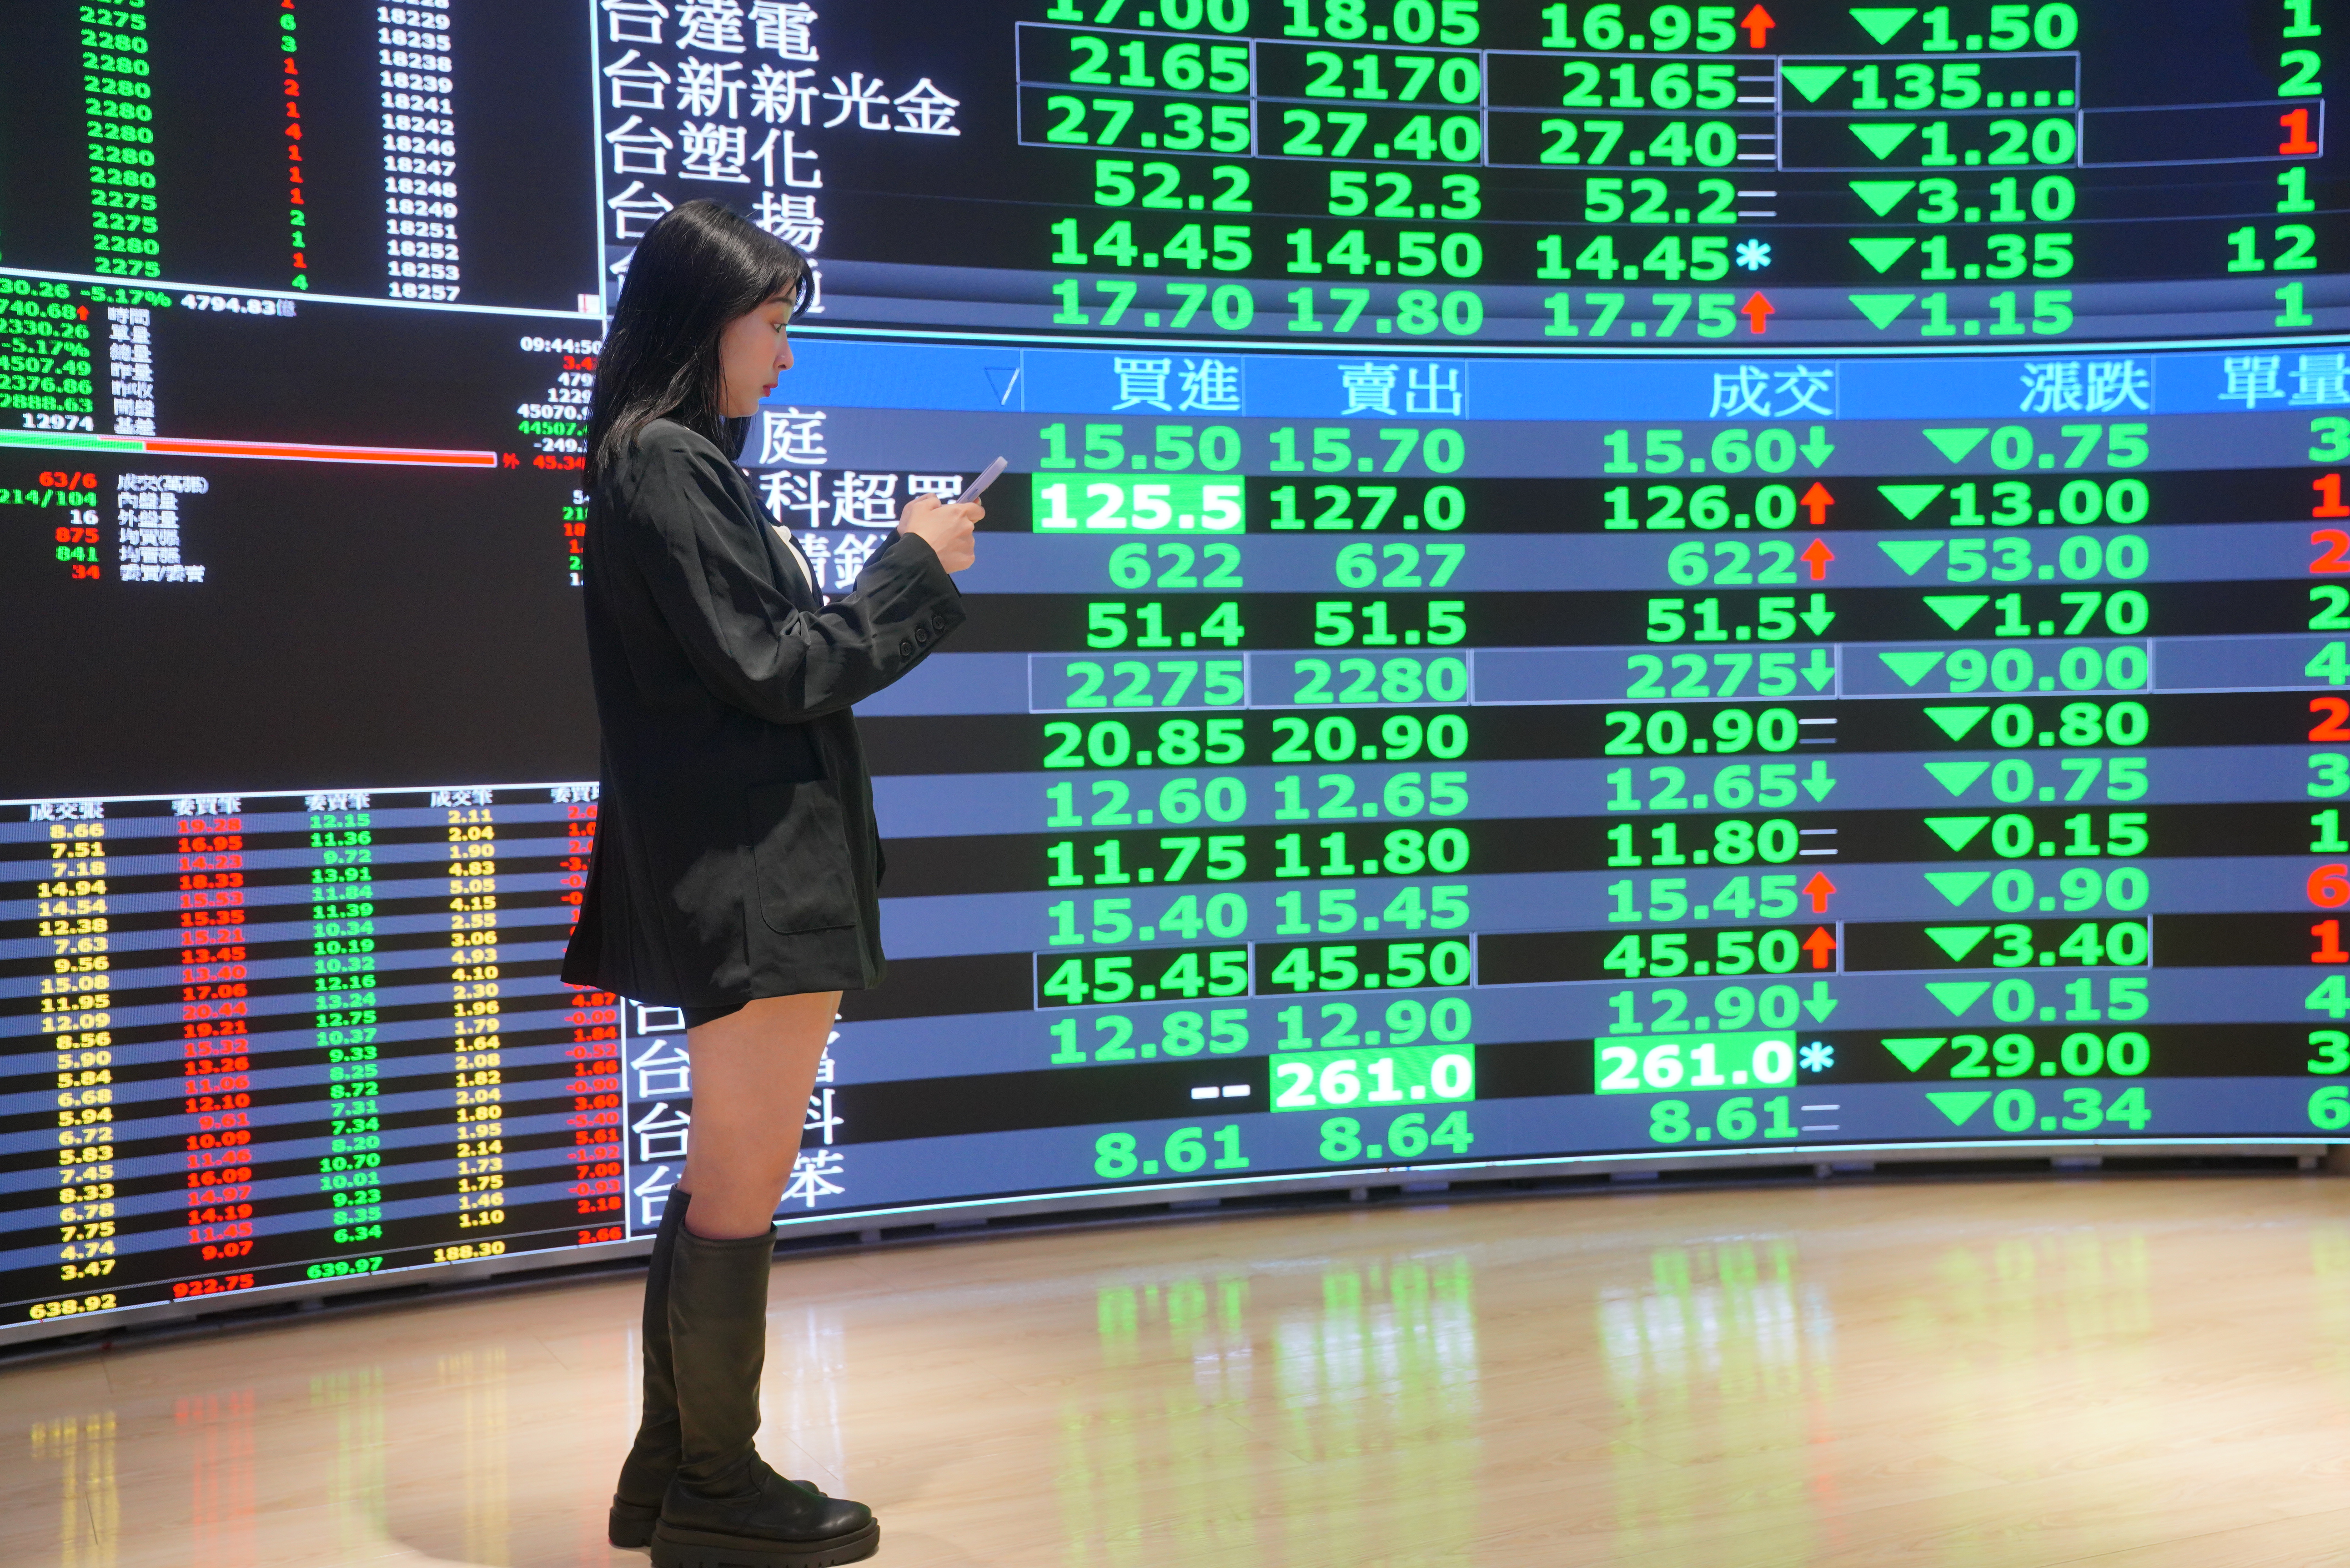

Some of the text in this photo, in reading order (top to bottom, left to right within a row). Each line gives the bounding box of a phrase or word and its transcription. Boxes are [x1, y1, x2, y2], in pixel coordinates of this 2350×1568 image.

[80, 6, 146, 30] 2275
[280, 14, 296, 30] 6
[379, 7, 450, 30] 18229
[1047, 0, 2321, 52] 17.00 18.05 16.95 1.50 1
[380, 28, 451, 50] 18235
[601, 0, 819, 61] 台達電
[81, 29, 148, 54] 2280
[281, 35, 297, 52] 3
[382, 70, 452, 93] 18239
[1070, 36, 1250, 93] 2165
[1306, 51, 1480, 104] 2170
[1563, 61, 1736, 110] 2165
[603, 49, 960, 136] 台新新光金
[383, 92, 452, 114] 18241
[87, 121, 153, 143] 2280
[285, 123, 302, 140] 4
[384, 114, 454, 135] 18242
[1047, 95, 2317, 167] 27.35 27.40 27.40 1.20 1
[605, 115, 823, 188] 台塑化
[386, 156, 456, 176] 18247
[1095, 159, 2075, 224] 52.2 52.3 52.2 3.10
[387, 198, 457, 218] 18249
[92, 211, 158, 233] 2275
[94, 234, 159, 255] 2280
[1051, 218, 2317, 281] 14.45 14.50 14.45 1.35 12
[95, 256, 160, 277] 2275
[292, 274, 308, 290] 4
[391, 282, 460, 301] 18257
[80, 286, 172, 307] -5.17%
[1052, 279, 2073, 337] 17.70 17.80 17.75 1.15
[2, 337, 90, 357] -5.17%
[520, 336, 603, 355] 09:44:50
[1112, 353, 2350, 418] 買進 賣出 成交 漲跌 單量
[23, 412, 94, 431] 12974
[1040, 423, 2148, 473] 15.50 15.70 15.60 0.75
[40, 472, 97, 490] 63/6
[1042, 478, 2149, 531] 125.5 127.0 126.0 13.00
[70, 509, 99, 525] 16
[55, 527, 99, 543] 875
[56, 546, 98, 562] 841
[1109, 535, 2149, 588] 622 627 622 53.00
[72, 565, 100, 579] 34
[1067, 646, 2148, 708] 2275 2280 2275 90.00
[1043, 701, 2149, 768] 20.85 20.90 20.90 0.80
[179, 818, 241, 833] 19.28
[311, 814, 370, 828] 12.15
[449, 809, 492, 823] 2.11
[51, 842, 105, 858] 7.51
[324, 849, 371, 864] 9.72
[180, 855, 242, 870] 14.23
[449, 861, 495, 876] 4.83
[311, 867, 372, 883] 13.91
[39, 880, 107, 898] 14.94
[181, 891, 243, 908] 15.53
[450, 896, 496, 911] 4.15
[40, 918, 108, 936] 12.38
[314, 920, 373, 937] 10.34
[452, 931, 497, 947] 3.06
[55, 956, 109, 973] 9.56
[182, 946, 246, 964] 13.45
[1044, 922, 2148, 1004] 45.45 45.50 45.50 3.40
[315, 975, 376, 991] 12.16
[454, 983, 498, 999] 2.30
[572, 992, 616, 1007] 4.87
[183, 1002, 247, 1020] 20.44
[43, 1013, 110, 1032] 12.09
[317, 1028, 377, 1046] 10.37
[455, 1035, 500, 1052] 1.64
[574, 1026, 618, 1042] 1.84
[185, 1056, 249, 1075] 13.26
[1277, 1032, 2150, 1107] 261.0 261.0 29.00
[57, 1069, 113, 1088] 5.84
[199, 1113, 249, 1130] 9.61
[331, 1117, 380, 1135] 7.34
[567, 1112, 618, 1127] -5.40
[1095, 1087, 2151, 1178] 8.61 8.64 8.61 0.34
[457, 1140, 503, 1157] 2.14
[320, 1153, 381, 1173] 10.70
[577, 1162, 621, 1180] 7.00
[459, 1175, 503, 1192] 1.75
[188, 1186, 251, 1206] 14.97
[333, 1189, 381, 1207] 9.23
[60, 1221, 115, 1242] 7.75
[578, 1227, 622, 1244] 2.66
[434, 1241, 505, 1262] 188.30
[307, 1257, 383, 1279] 639.97
[173, 1274, 254, 1298] 922.75
[30, 1294, 116, 1319] 638.92
